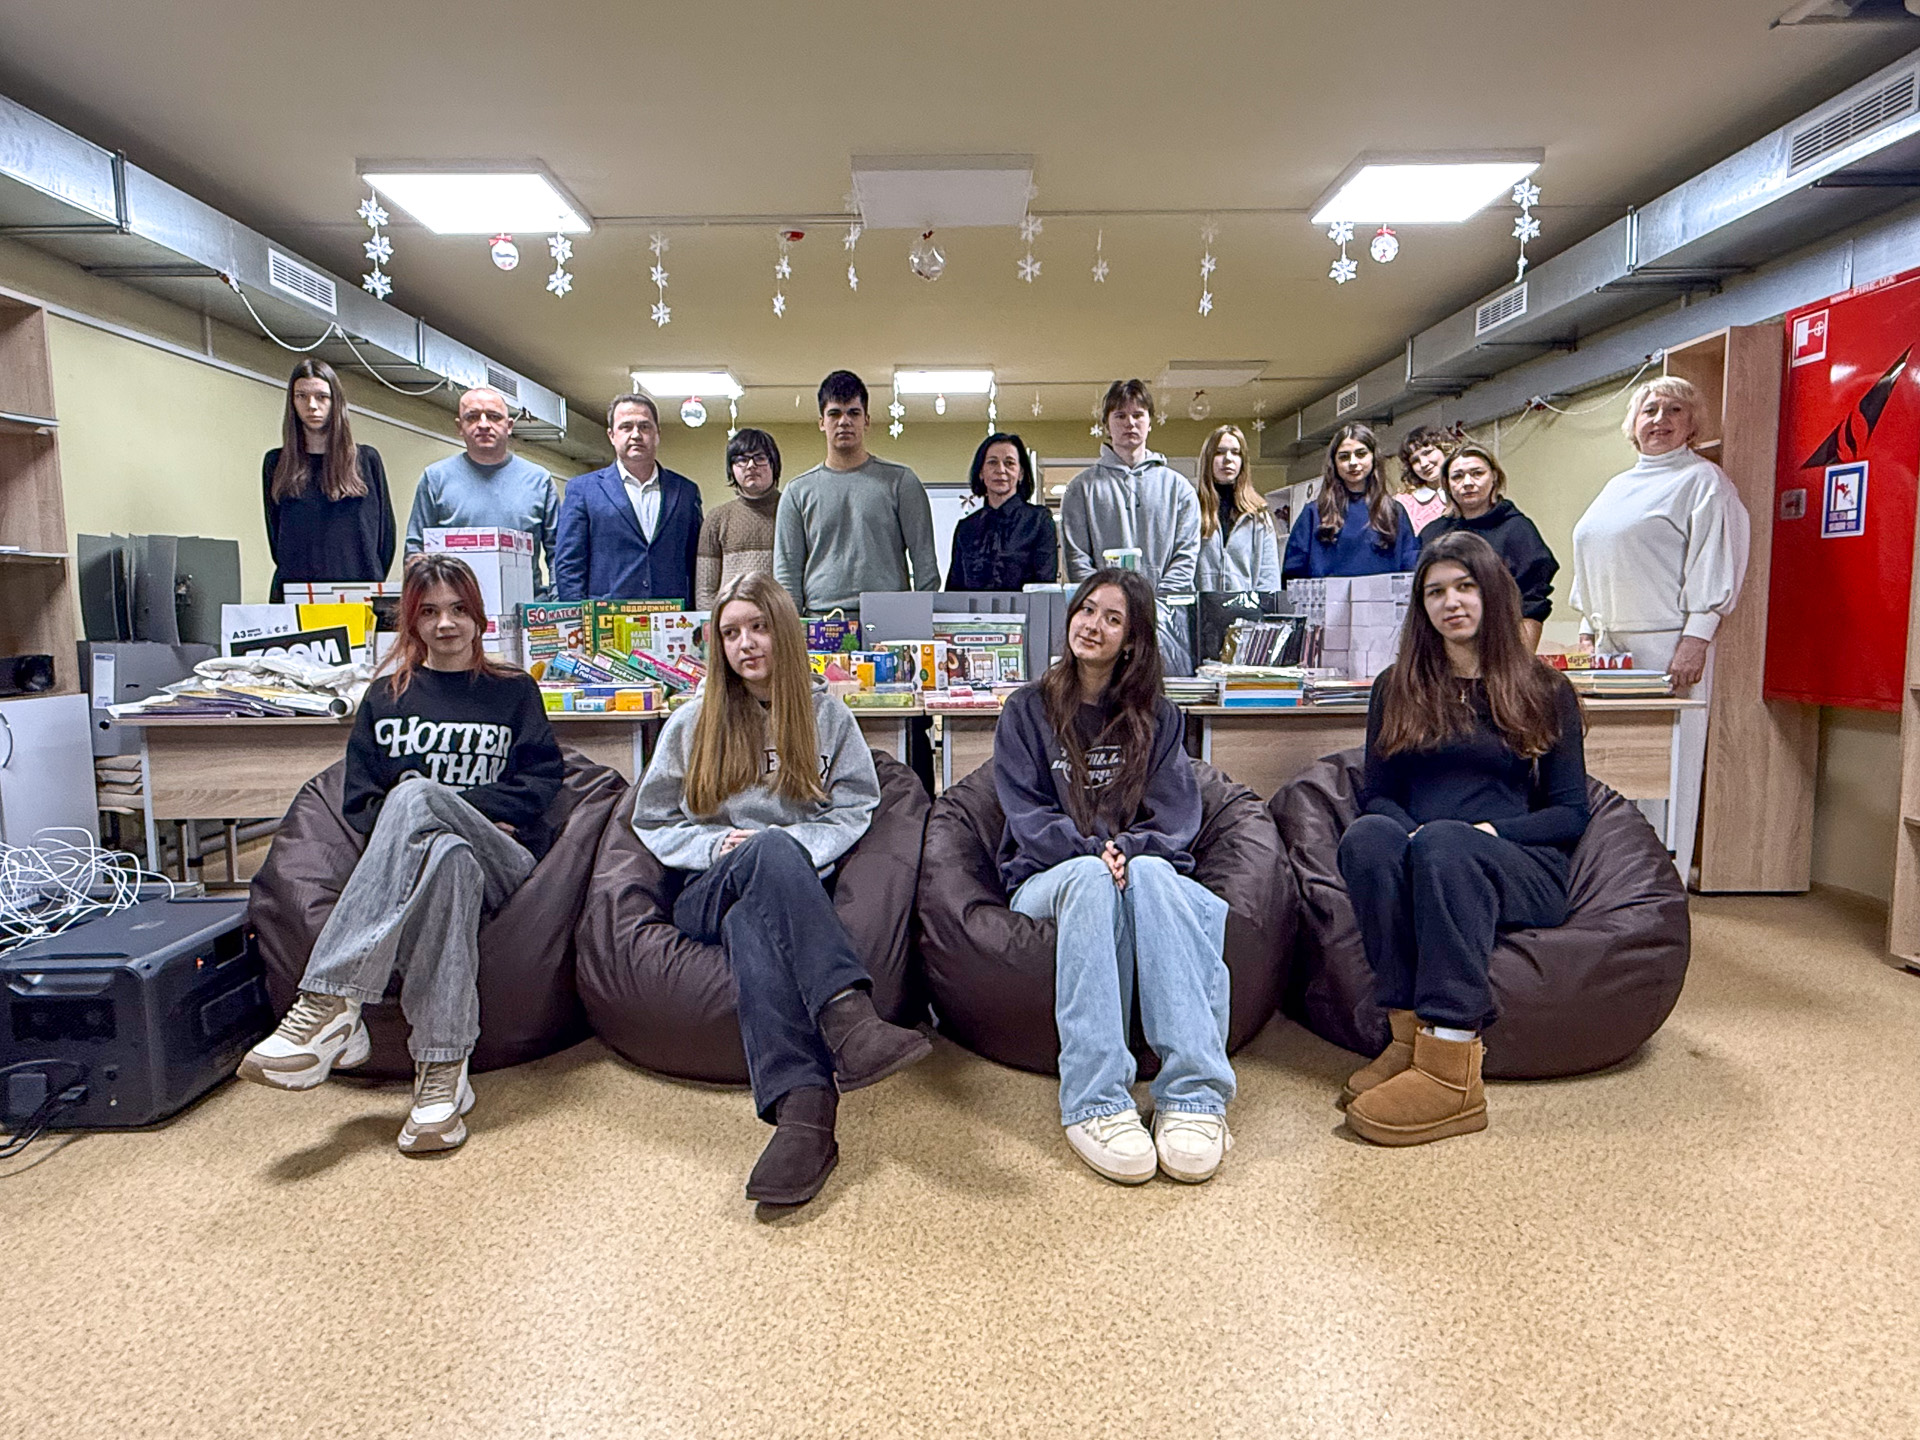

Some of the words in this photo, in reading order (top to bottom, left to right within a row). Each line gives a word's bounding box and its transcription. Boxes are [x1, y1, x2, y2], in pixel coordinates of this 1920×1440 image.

[527, 608, 547, 624] 50
[232, 630, 247, 640] A3
[374, 716, 512, 758] HOTTER
